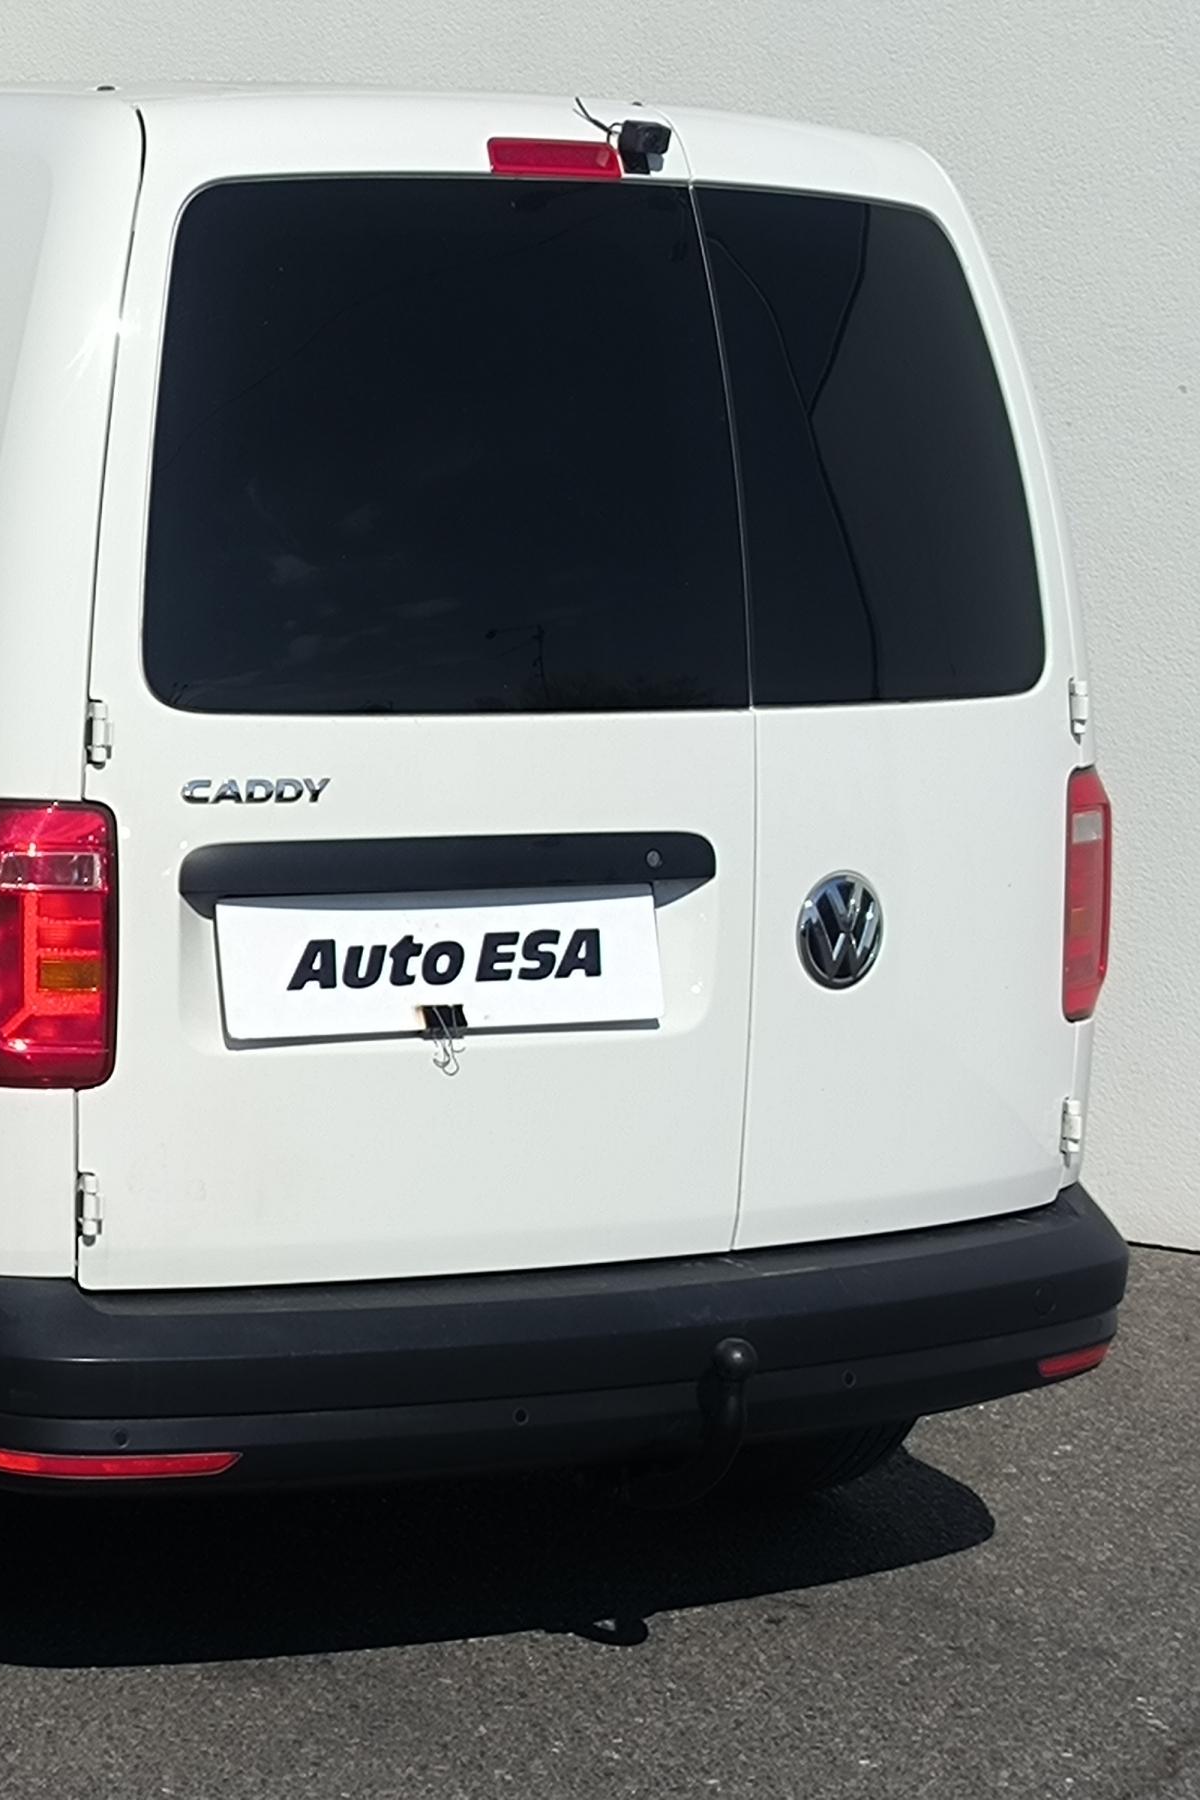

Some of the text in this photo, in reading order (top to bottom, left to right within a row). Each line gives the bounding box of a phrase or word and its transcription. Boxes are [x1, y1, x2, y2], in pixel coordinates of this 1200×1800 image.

[181, 778, 331, 804] CADDY
[287, 928, 601, 991] Auto ESA
[799, 873, 882, 984] VW
